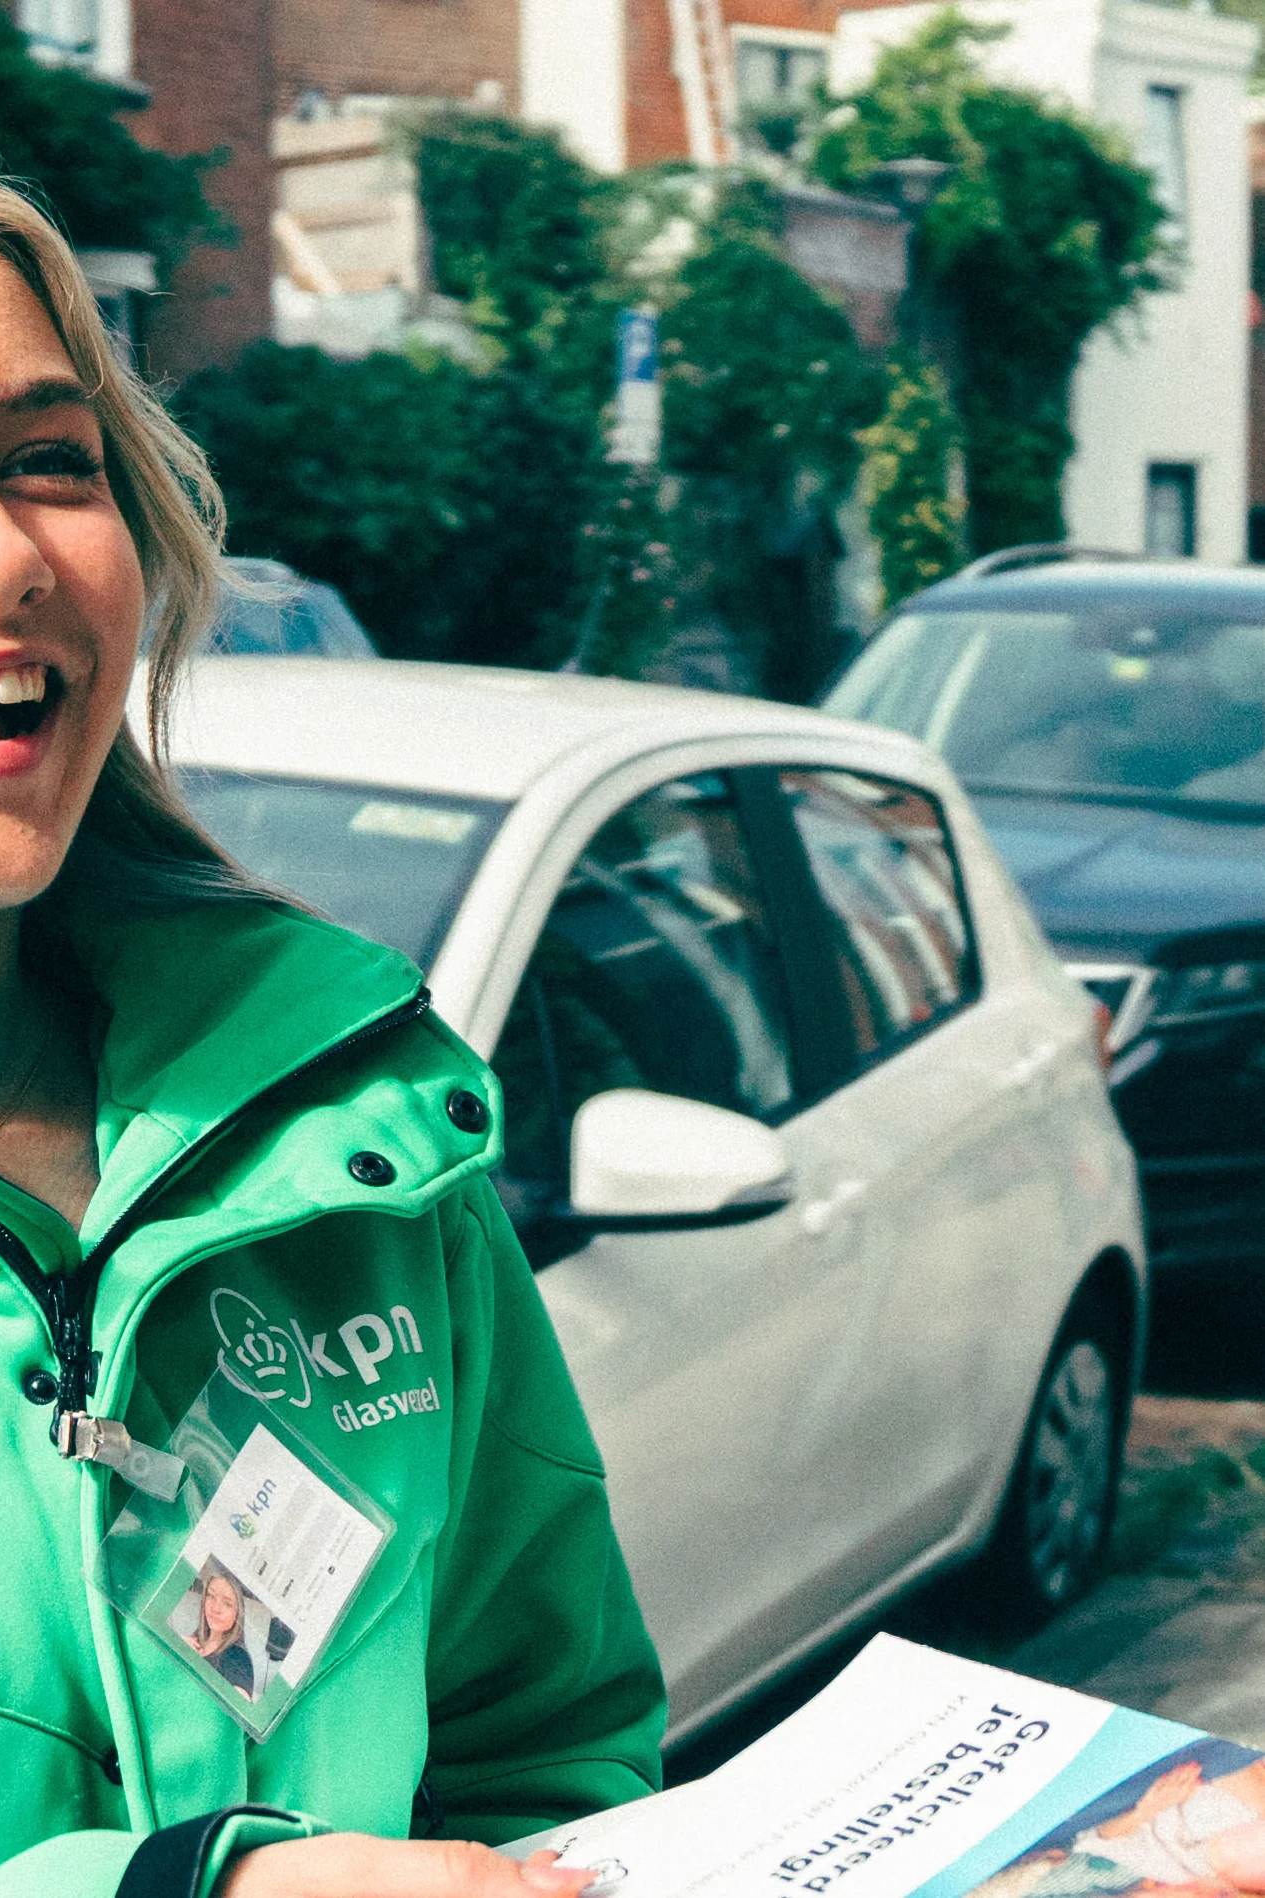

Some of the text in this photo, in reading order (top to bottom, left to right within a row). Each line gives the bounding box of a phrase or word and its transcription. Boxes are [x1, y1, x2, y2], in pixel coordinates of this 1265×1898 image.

[289, 1304, 424, 1386] kpn
[332, 1376, 442, 1433] Glasvezel
[245, 1477, 278, 1517] kpn
[976, 1703, 1023, 1735] je
[770, 1741, 983, 1882] bestelling!
[801, 1719, 1051, 1894] Gefeliciteerd
